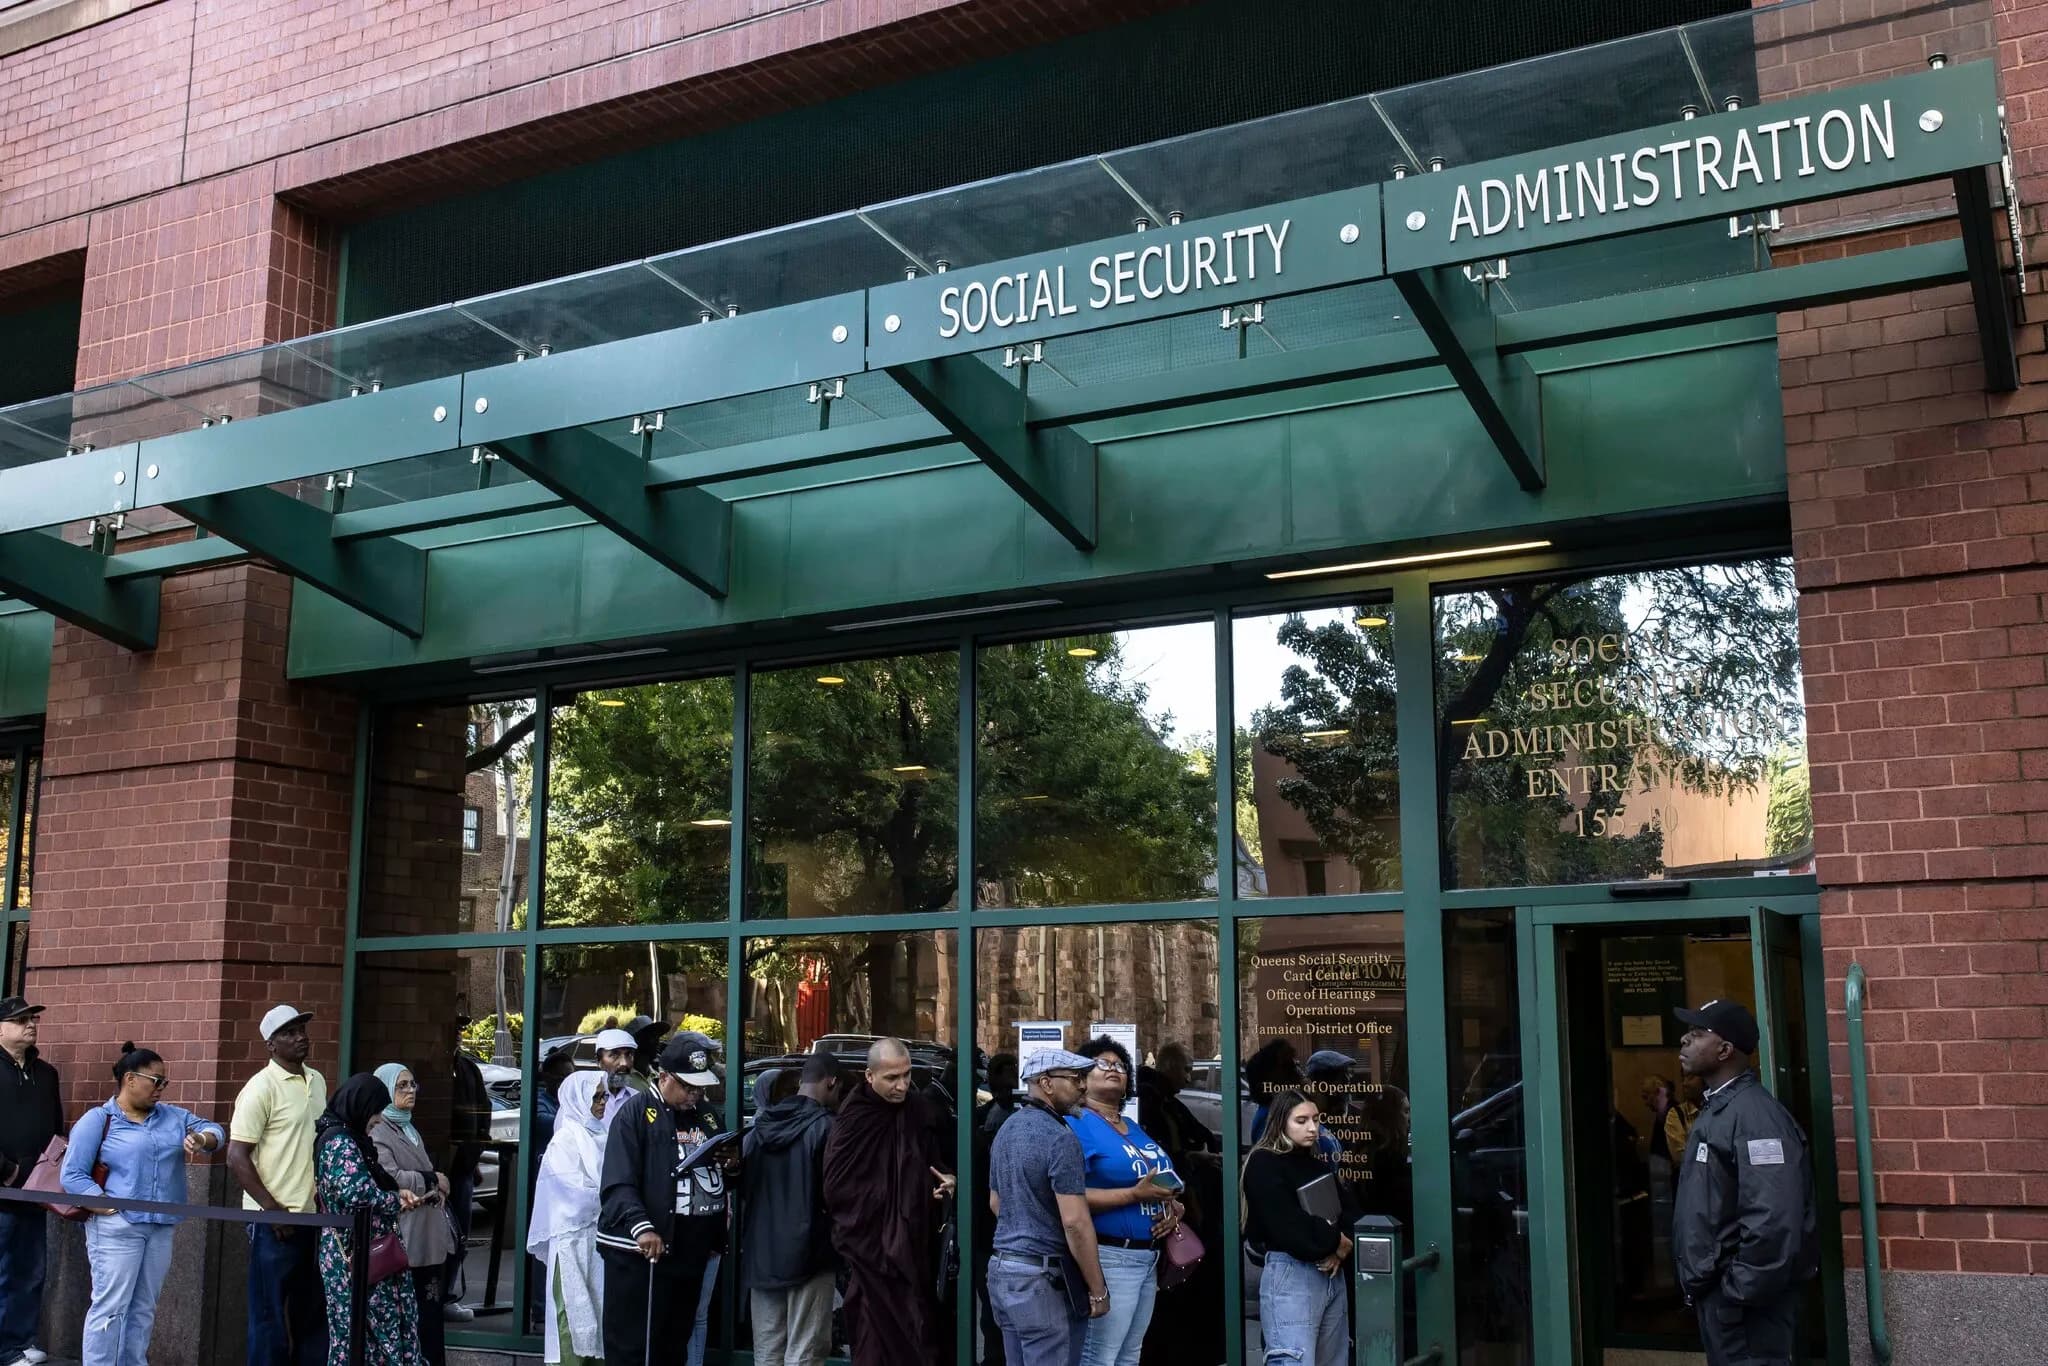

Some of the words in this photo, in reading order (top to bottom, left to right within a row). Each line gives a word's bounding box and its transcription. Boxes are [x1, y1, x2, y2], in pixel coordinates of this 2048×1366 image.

[939, 265, 1077, 338] SOCIAL
[1089, 219, 1291, 309] SECURITY
[1449, 98, 1896, 242] ADMINISTRATION
[1551, 629, 1679, 667] SOCIAL
[1530, 669, 1708, 712] SECURITY
[1461, 705, 1785, 760] ADMINISTRATION
[1526, 755, 1723, 799] ENTRANCE
[1250, 955, 1296, 969] Queens
[1298, 953, 1335, 966] Social
[1338, 952, 1391, 967] Security
[1283, 969, 1313, 982] Card
[1315, 969, 1357, 982] Center
[1266, 988, 1302, 1001] Office
[1303, 988, 1317, 1000] of
[1319, 988, 1376, 1002] Hearings
[1286, 1003, 1356, 1018] Operations
[1306, 1021, 1353, 1035] District
[1355, 1021, 1393, 1034] Office
[1303, 1081, 1317, 1093] of
[1318, 1080, 1383, 1095] Operation
[1318, 1112, 1361, 1125] Center
[1332, 1151, 1368, 1163] Office
